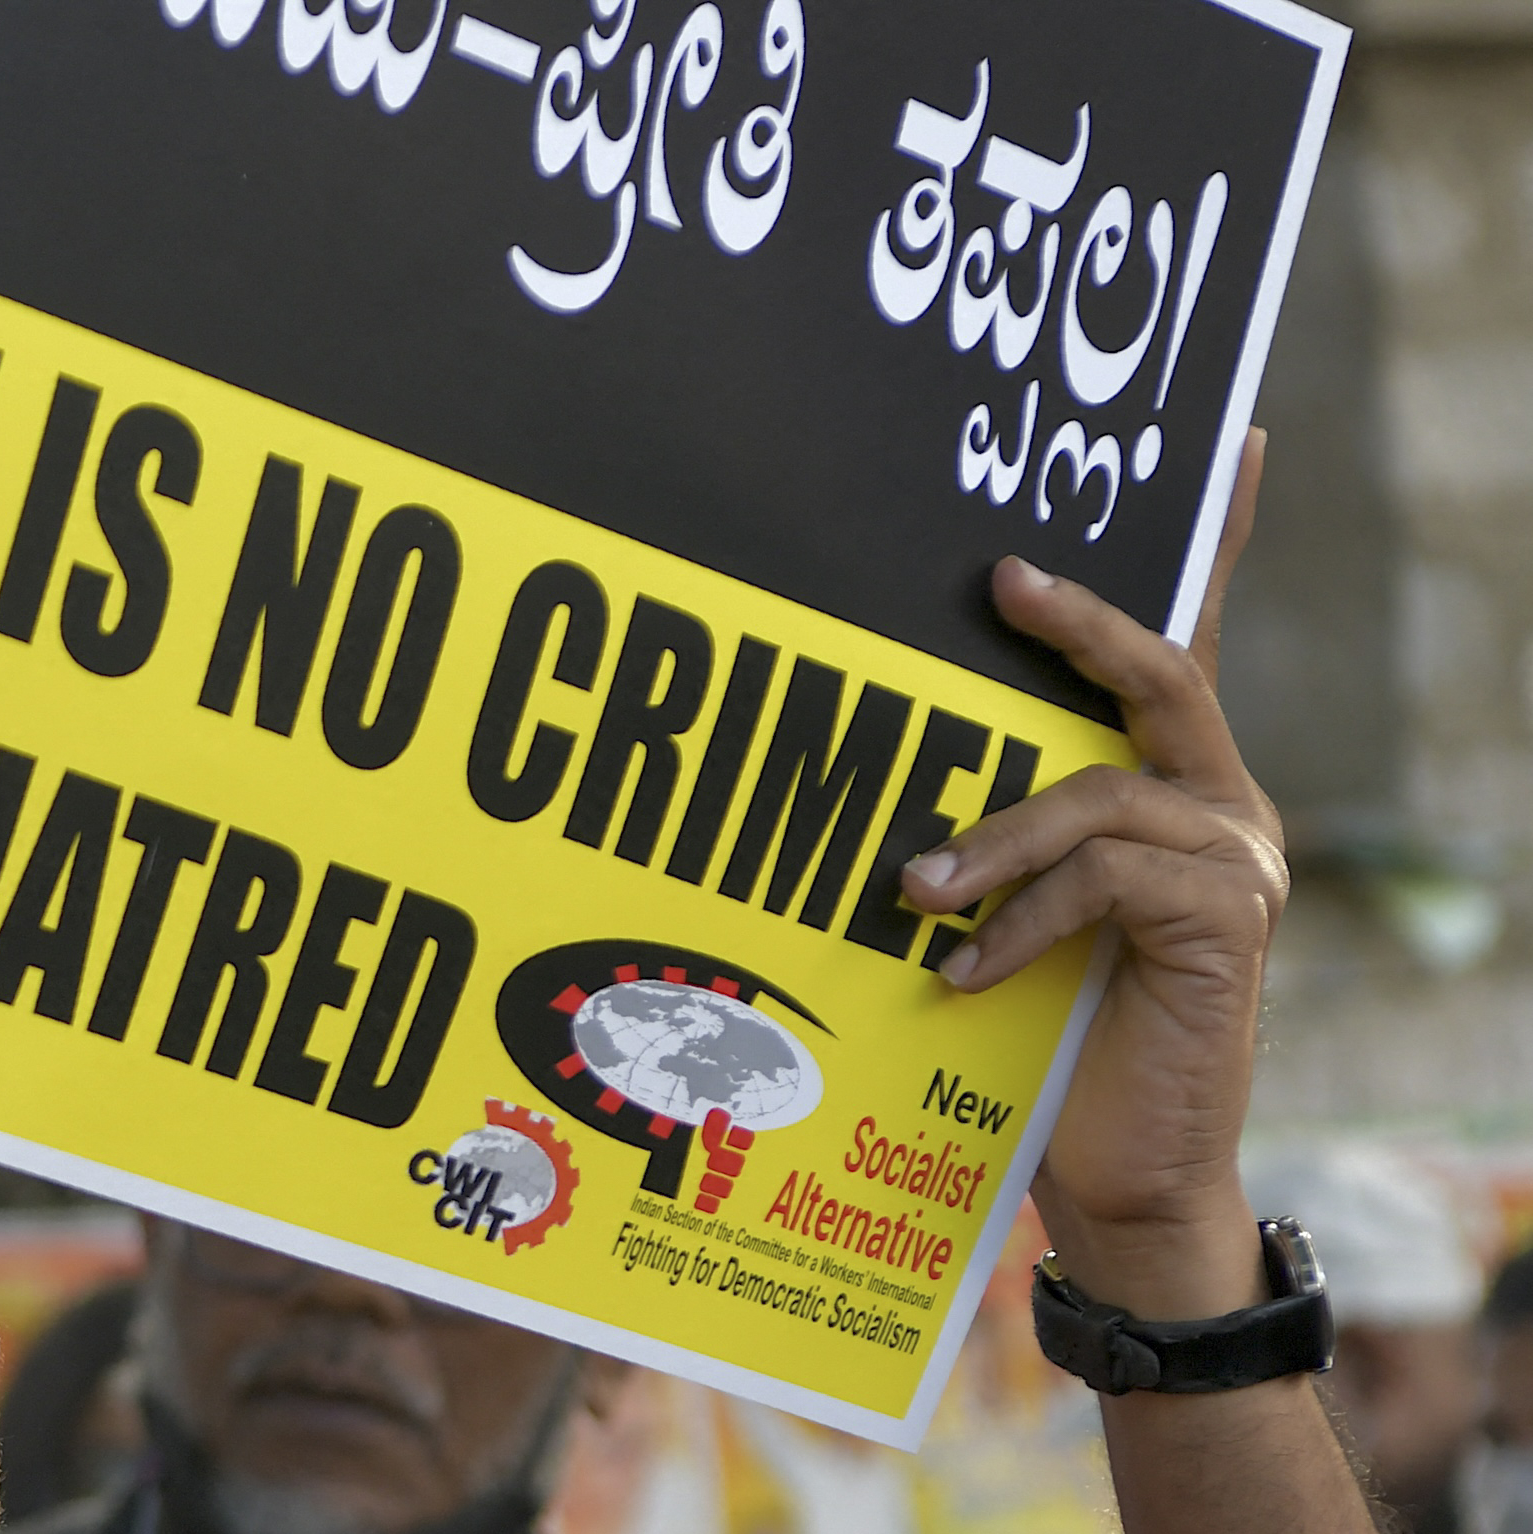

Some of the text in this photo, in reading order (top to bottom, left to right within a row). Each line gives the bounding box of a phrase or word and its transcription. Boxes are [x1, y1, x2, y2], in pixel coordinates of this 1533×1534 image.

[869, 56, 1230, 543] ತಪ್ಪಲ್ಲ!
[197, 454, 461, 770] NO
[467, 561, 1043, 973] CRIME!
[922, 1067, 1013, 1135] New
[408, 1149, 503, 1204] CWI
[434, 1193, 516, 1242] CIT
[845, 1115, 986, 1214] Socialist
[630, 1193, 664, 1220] Indian
[663, 1203, 702, 1233] Section
[703, 1219, 718, 1236] of
[716, 1220, 734, 1243] the
[735, 1227, 792, 1262] Committee
[792, 1246, 811, 1268] for
[867, 1271, 937, 1311] International
[765, 1171, 953, 1280] Alternative
[611, 1221, 921, 1355] Fighting for Democratic Socialism
